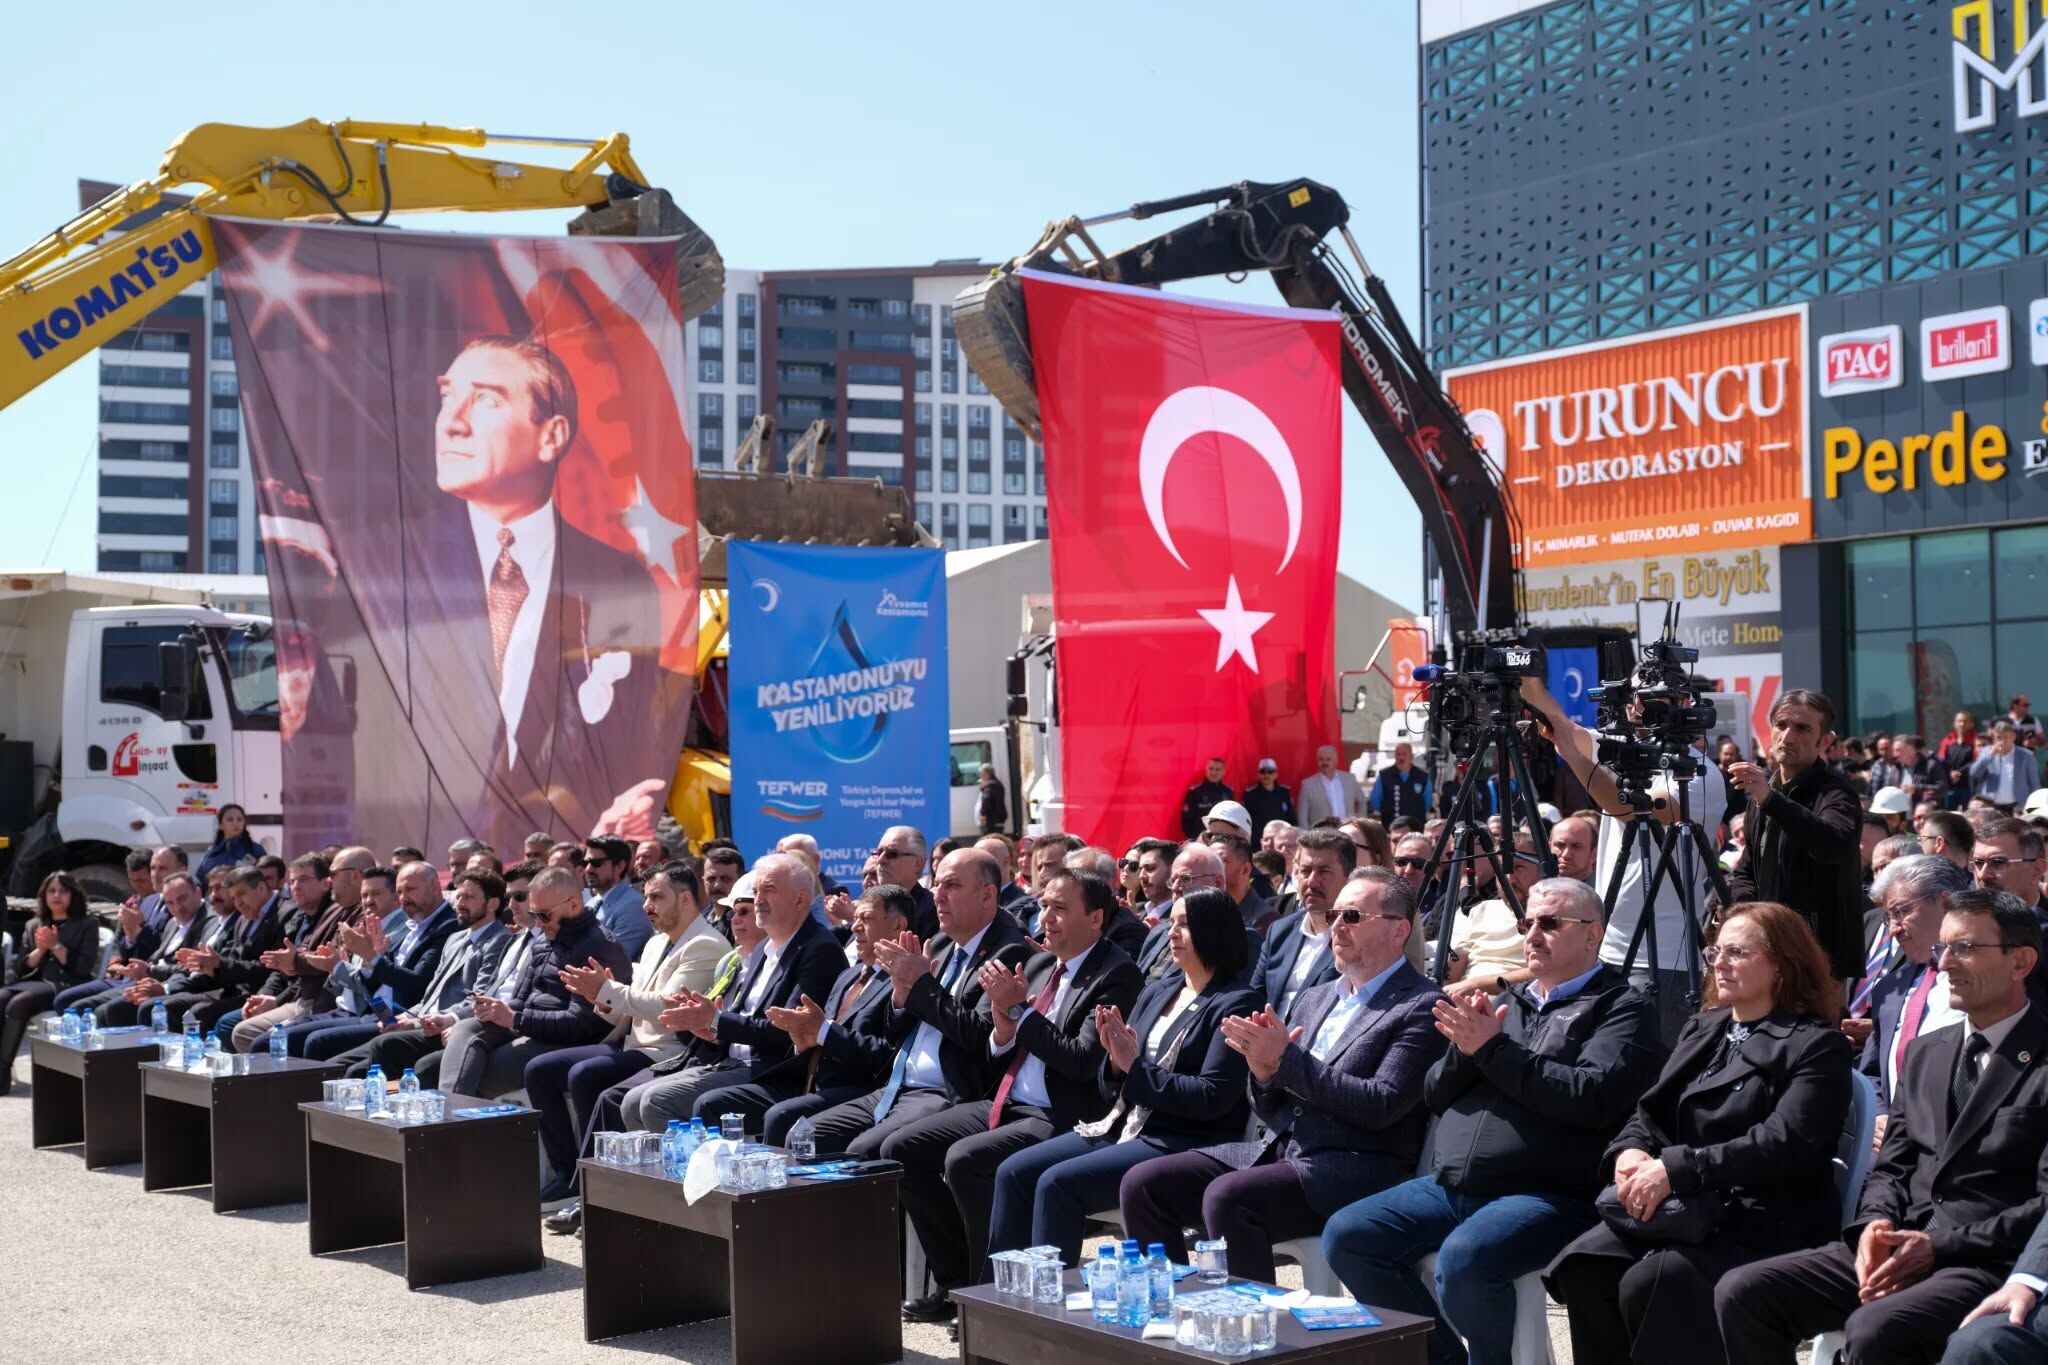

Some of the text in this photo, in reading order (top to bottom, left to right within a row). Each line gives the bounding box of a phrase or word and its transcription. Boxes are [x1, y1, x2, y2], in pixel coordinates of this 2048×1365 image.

[17, 229, 203, 360] KOMATSU
[1937, 324, 1993, 364] brillant
[1514, 358, 1789, 451] TURUNCU
[1556, 441, 1744, 488] DEKORASYON
[1824, 410, 2007, 499] Perde
[1610, 527, 1654, 544] MUTFAK
[1656, 523, 1700, 540] DOLABI
[1712, 518, 1754, 534] DUVAR
[1643, 561, 1675, 601] En
[1683, 549, 1770, 606] Büyük
[757, 658, 927, 708] KASTAMONU'YU
[771, 685, 915, 732] YENİLİYORUZ
[757, 781, 828, 796] TEFWER
